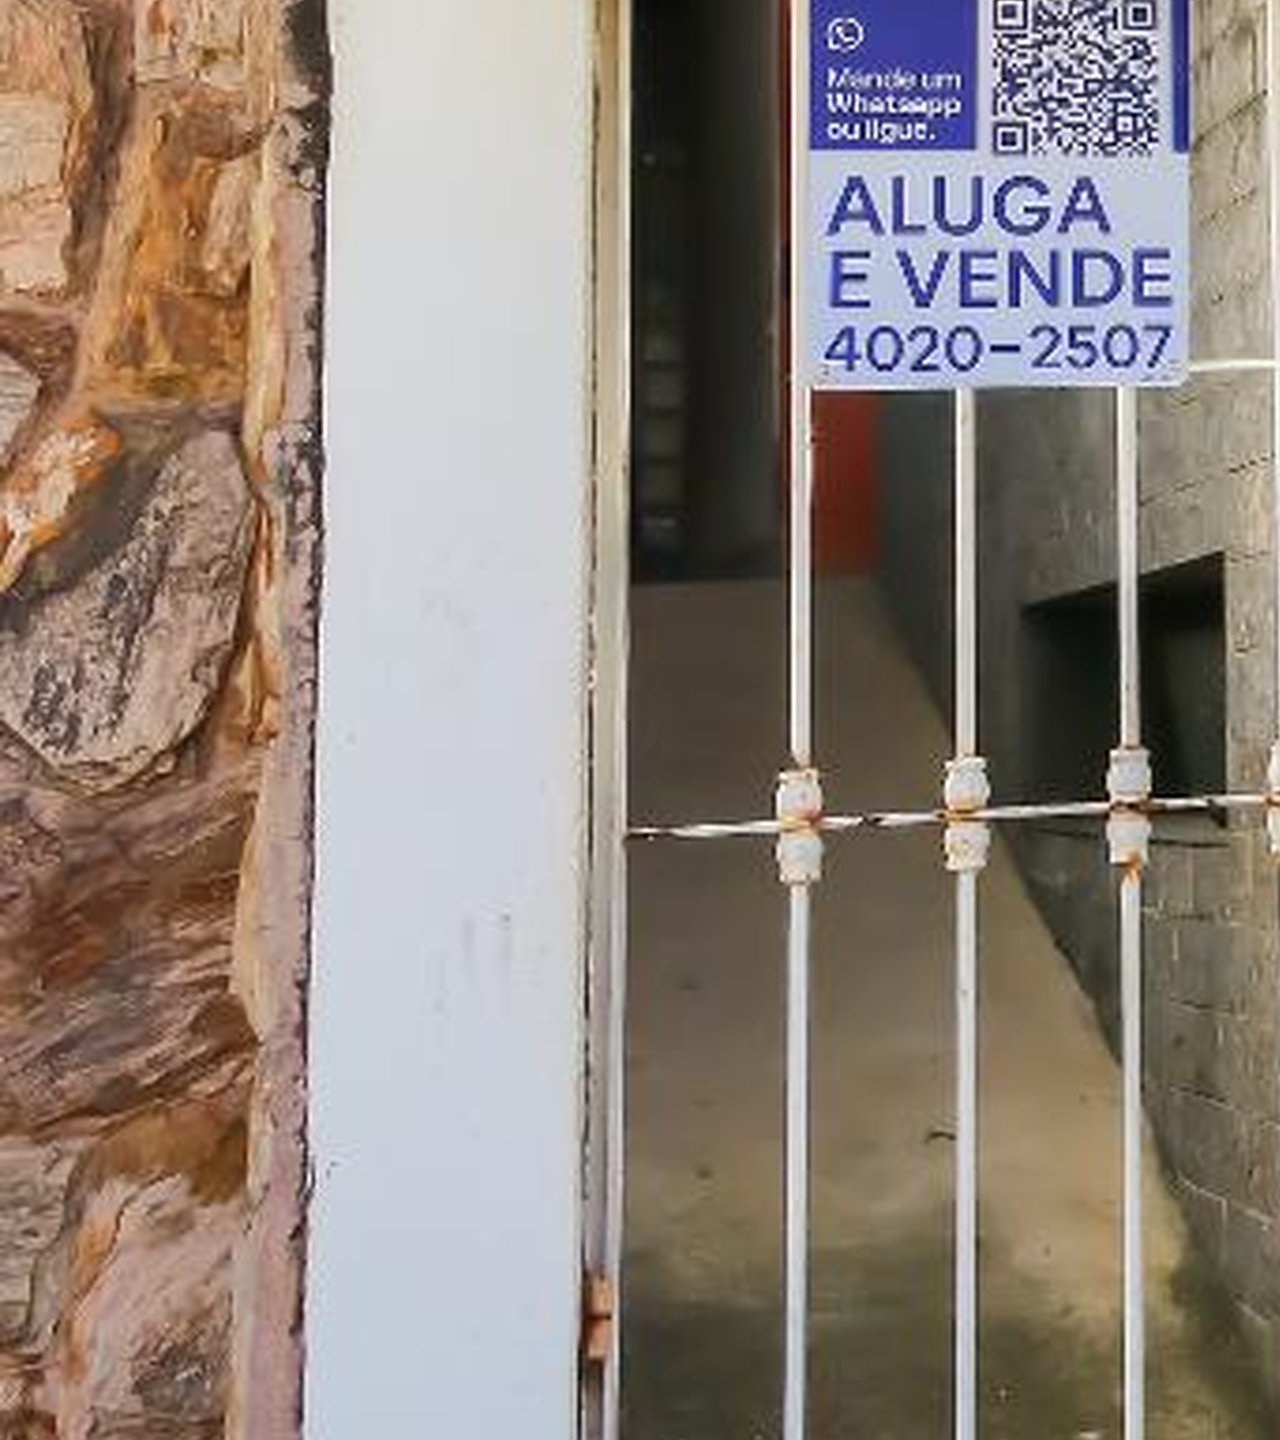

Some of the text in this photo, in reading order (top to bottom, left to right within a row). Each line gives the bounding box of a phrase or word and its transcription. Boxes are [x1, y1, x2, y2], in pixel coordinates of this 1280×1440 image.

[827, 67, 961, 90] Mande um
[827, 119, 937, 144] ou ligue.
[825, 175, 1111, 237] ALUGA
[829, 248, 1173, 309] E VENDE
[823, 324, 1173, 372] 4020-2507
